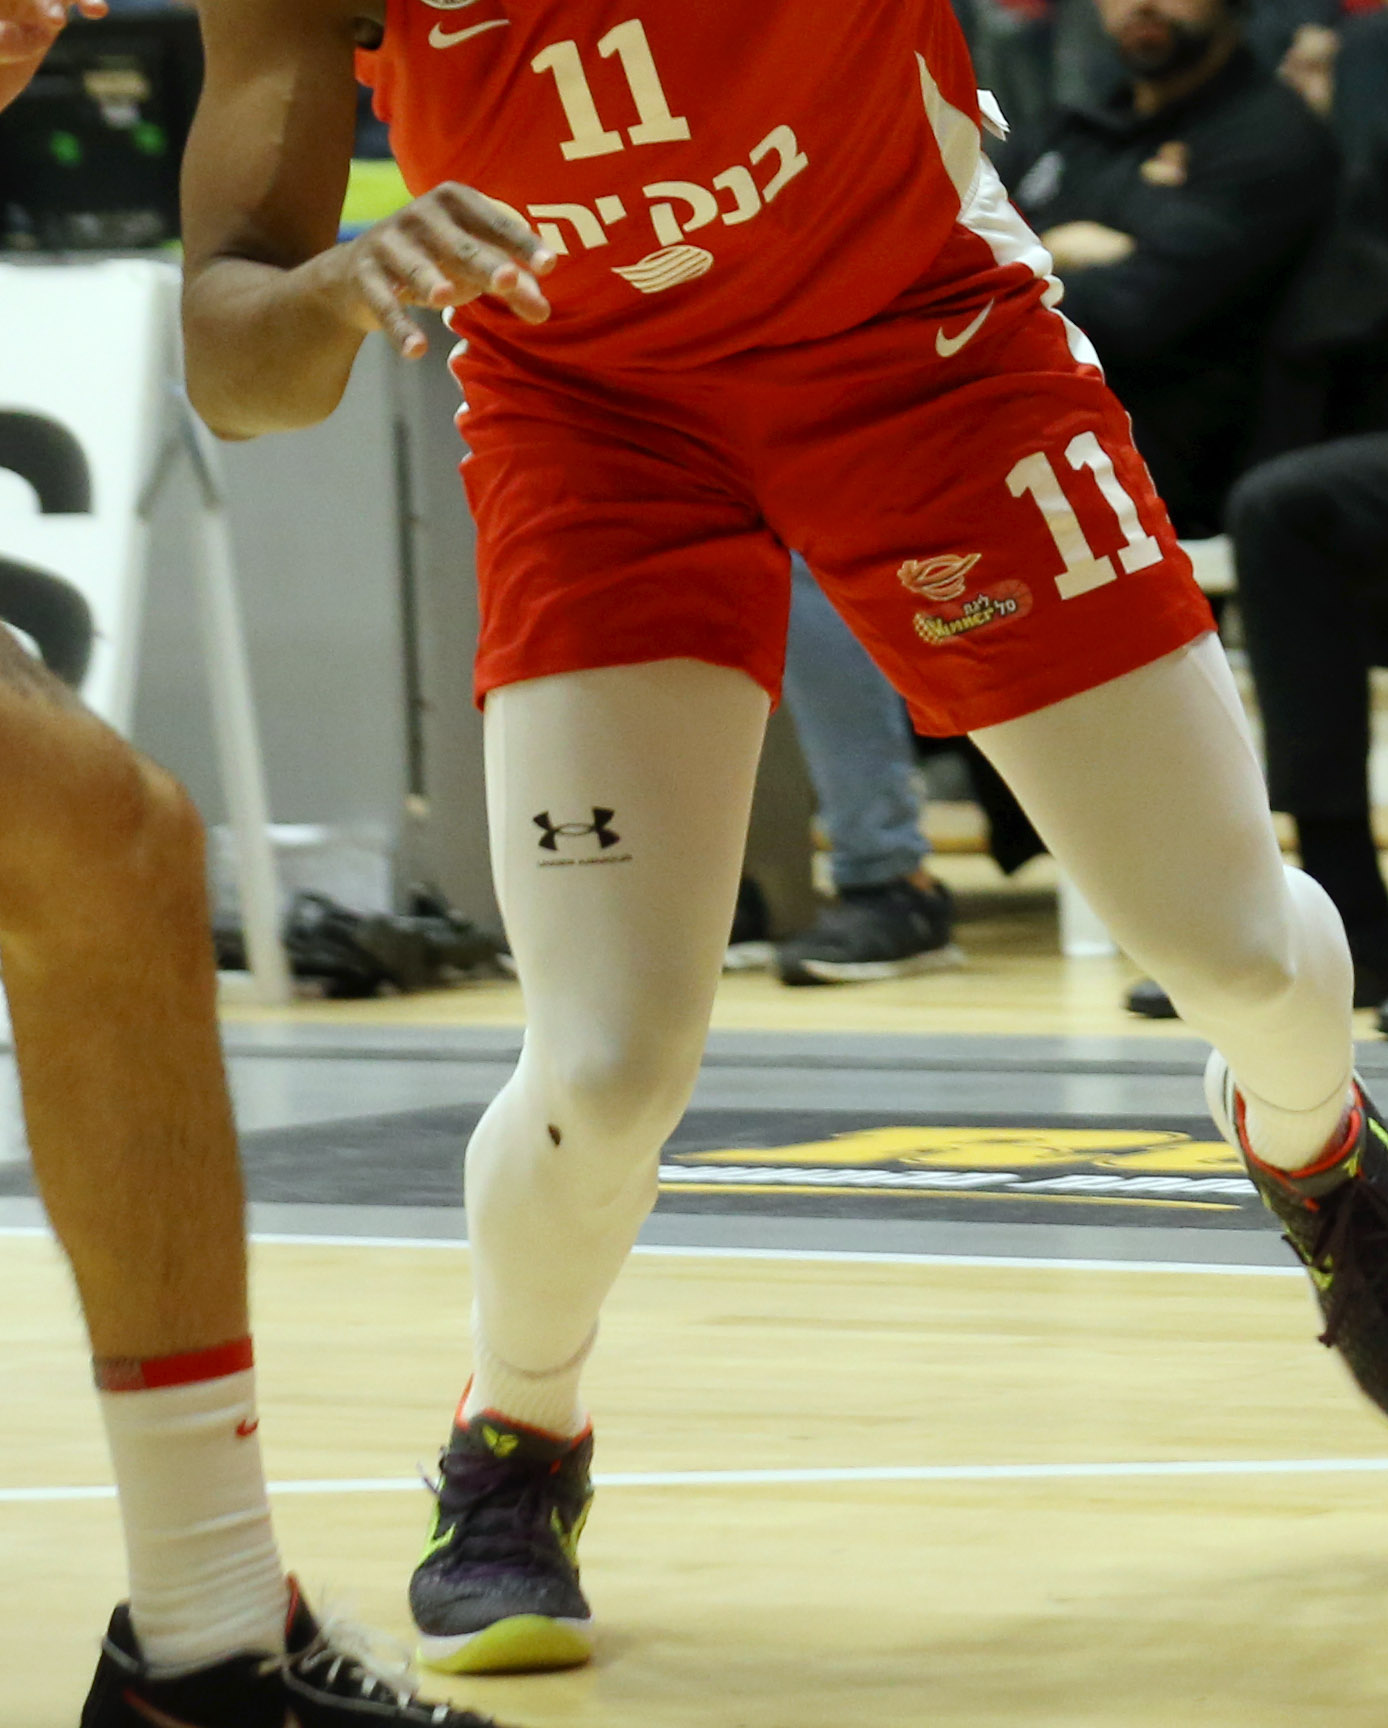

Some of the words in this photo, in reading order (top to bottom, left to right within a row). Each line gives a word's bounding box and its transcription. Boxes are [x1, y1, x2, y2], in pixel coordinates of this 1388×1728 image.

[531, 18, 691, 161] 11
[490, 193, 628, 256] יה
[642, 124, 808, 247] בנק
[1005, 430, 1163, 601] 11
